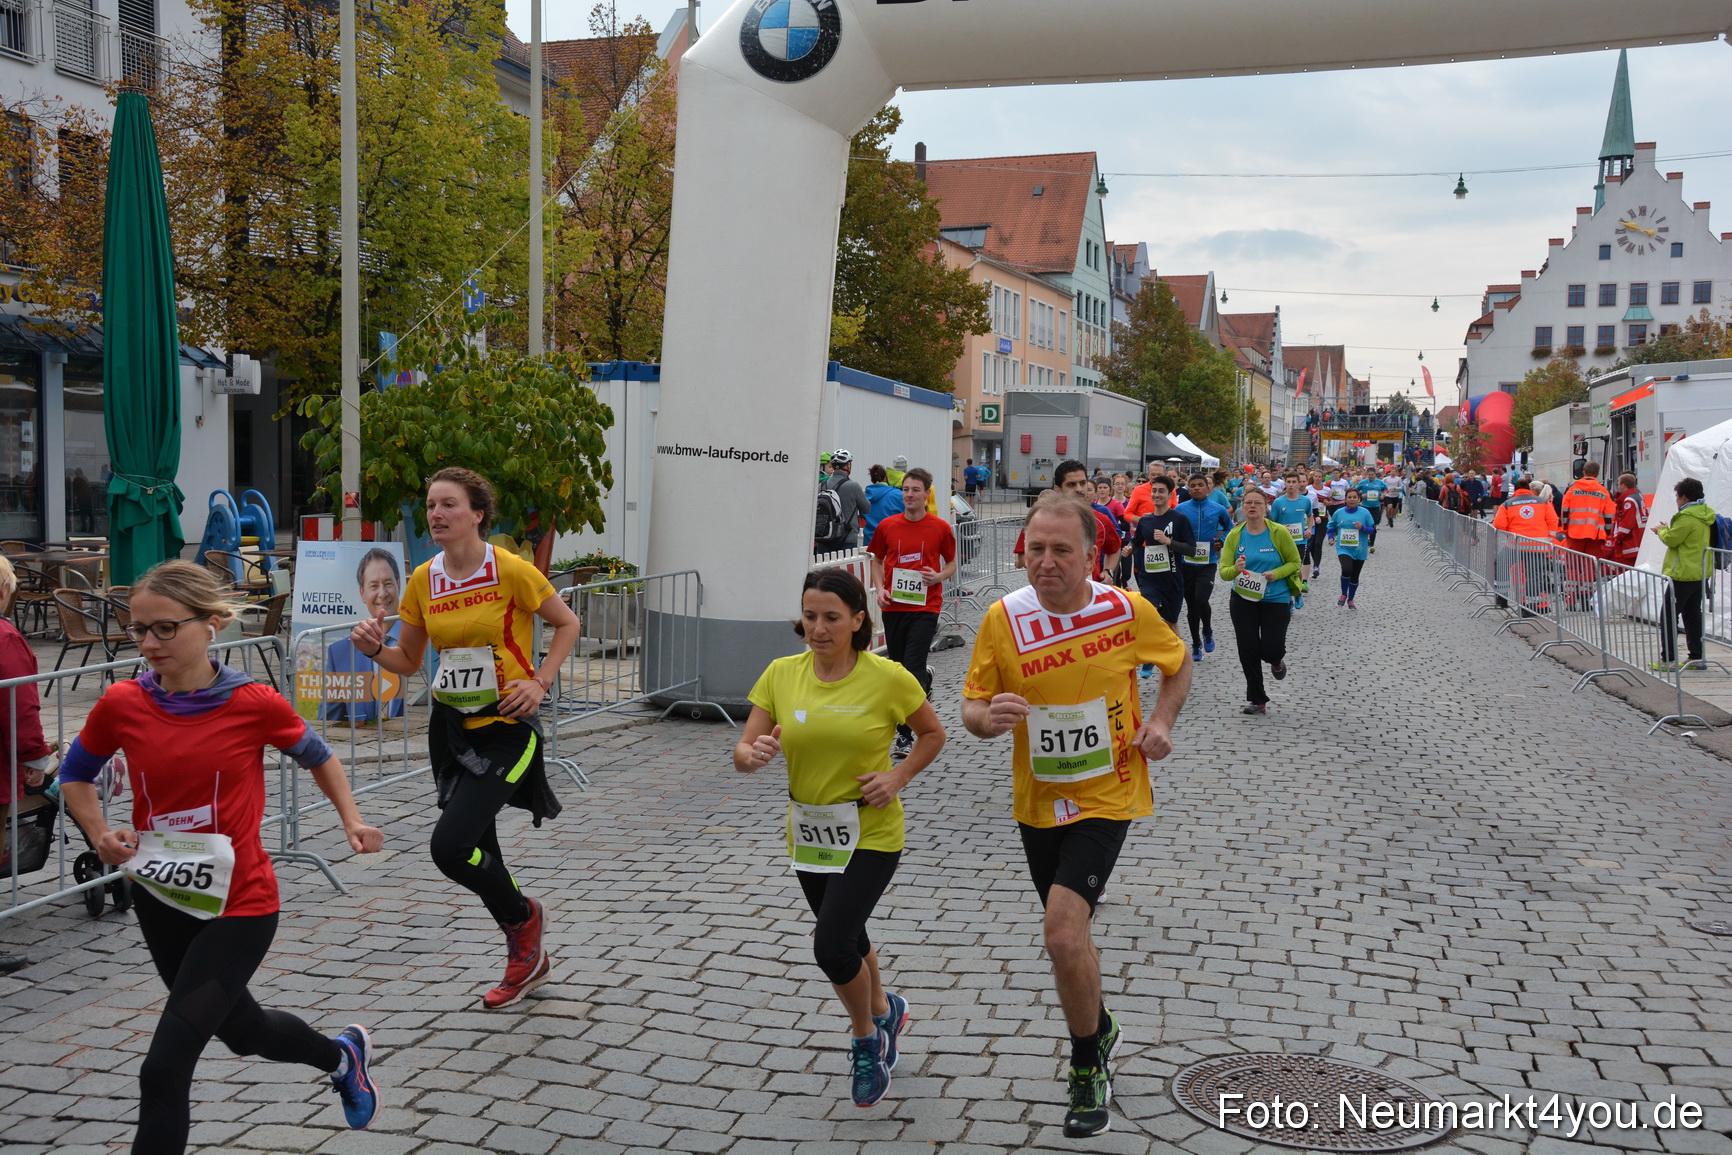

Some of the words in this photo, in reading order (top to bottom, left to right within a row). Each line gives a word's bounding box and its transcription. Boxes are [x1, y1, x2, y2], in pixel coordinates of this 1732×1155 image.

[217, 379, 228, 387] Hut
[236, 379, 250, 387] Mode
[984, 407, 997, 421] D
[657, 443, 789, 464] www.bmw-laufsport.de
[1146, 552, 1165, 563] 5248
[896, 578, 922, 592] 5154
[1238, 577, 1261, 592] 5208
[302, 592, 346, 604] WEITER.
[429, 600, 460, 615] MAX
[464, 591, 503, 607] BÖGL
[301, 604, 358, 616] MACHEN.
[1021, 648, 1076, 678] MAX
[1081, 629, 1136, 658] BÖGL
[440, 666, 484, 689] 5177
[447, 695, 480, 703] Christiane
[1056, 711, 1085, 720] BOCK
[1040, 724, 1099, 753] 5176
[1057, 759, 1088, 770] Johann
[169, 815, 194, 827] DEHN
[799, 823, 850, 846] 5115
[172, 841, 205, 851] BOCK
[136, 860, 215, 890] 5055
